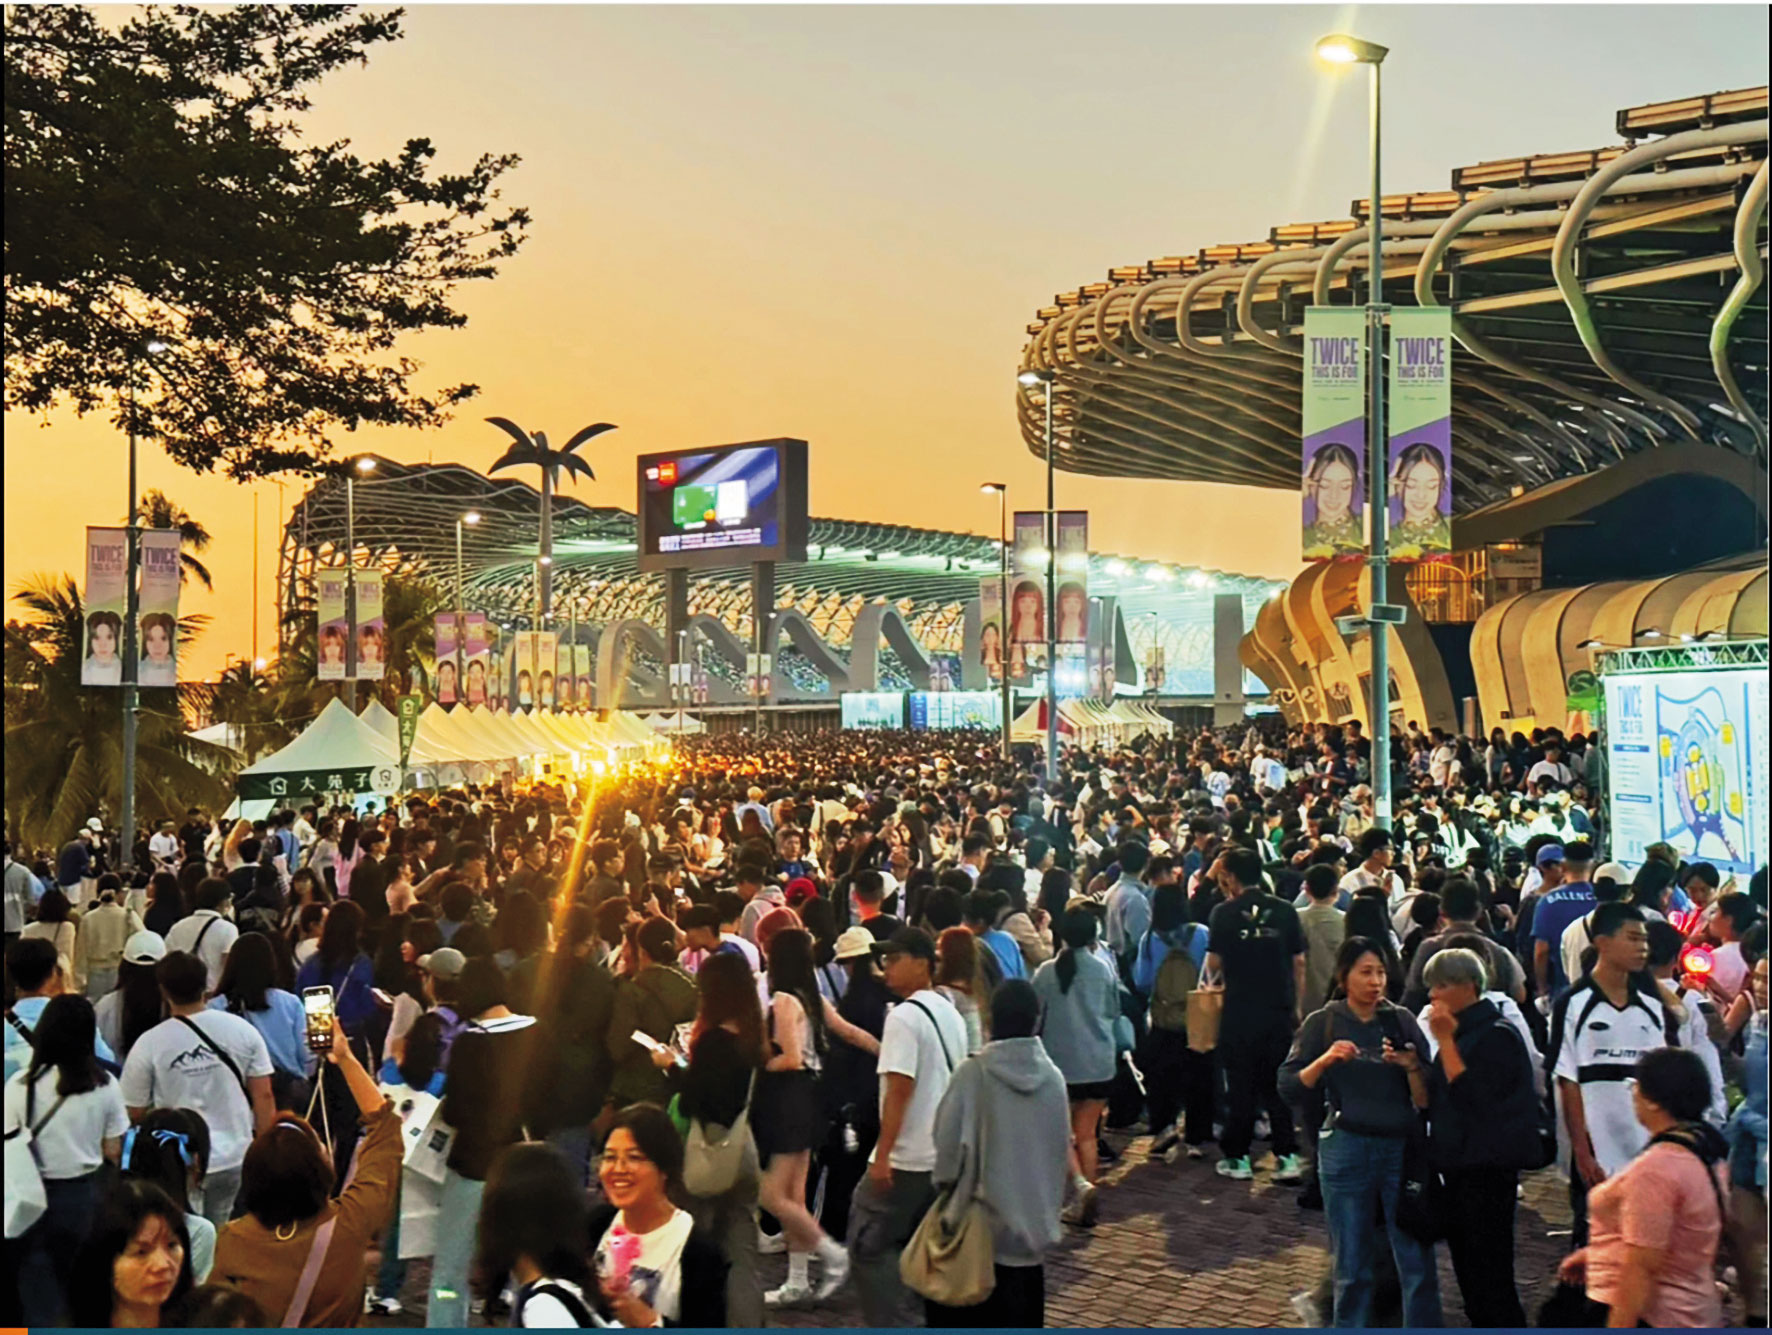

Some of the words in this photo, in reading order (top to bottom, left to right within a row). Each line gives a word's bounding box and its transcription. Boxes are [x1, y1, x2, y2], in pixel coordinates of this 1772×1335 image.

[1310, 337, 1359, 365] TWICE
[1395, 337, 1445, 365] TWICE
[1312, 366, 1330, 378] THIS
[1331, 366, 1340, 378] IS
[1342, 366, 1359, 378] FOR
[1397, 366, 1415, 378] THIS
[1417, 366, 1426, 378] IS
[1428, 366, 1445, 378] FOR
[91, 545, 123, 561] TWICE
[145, 547, 177, 564] TWICE
[301, 773, 369, 791] 大苑子
[1546, 891, 1594, 904] BALENC
